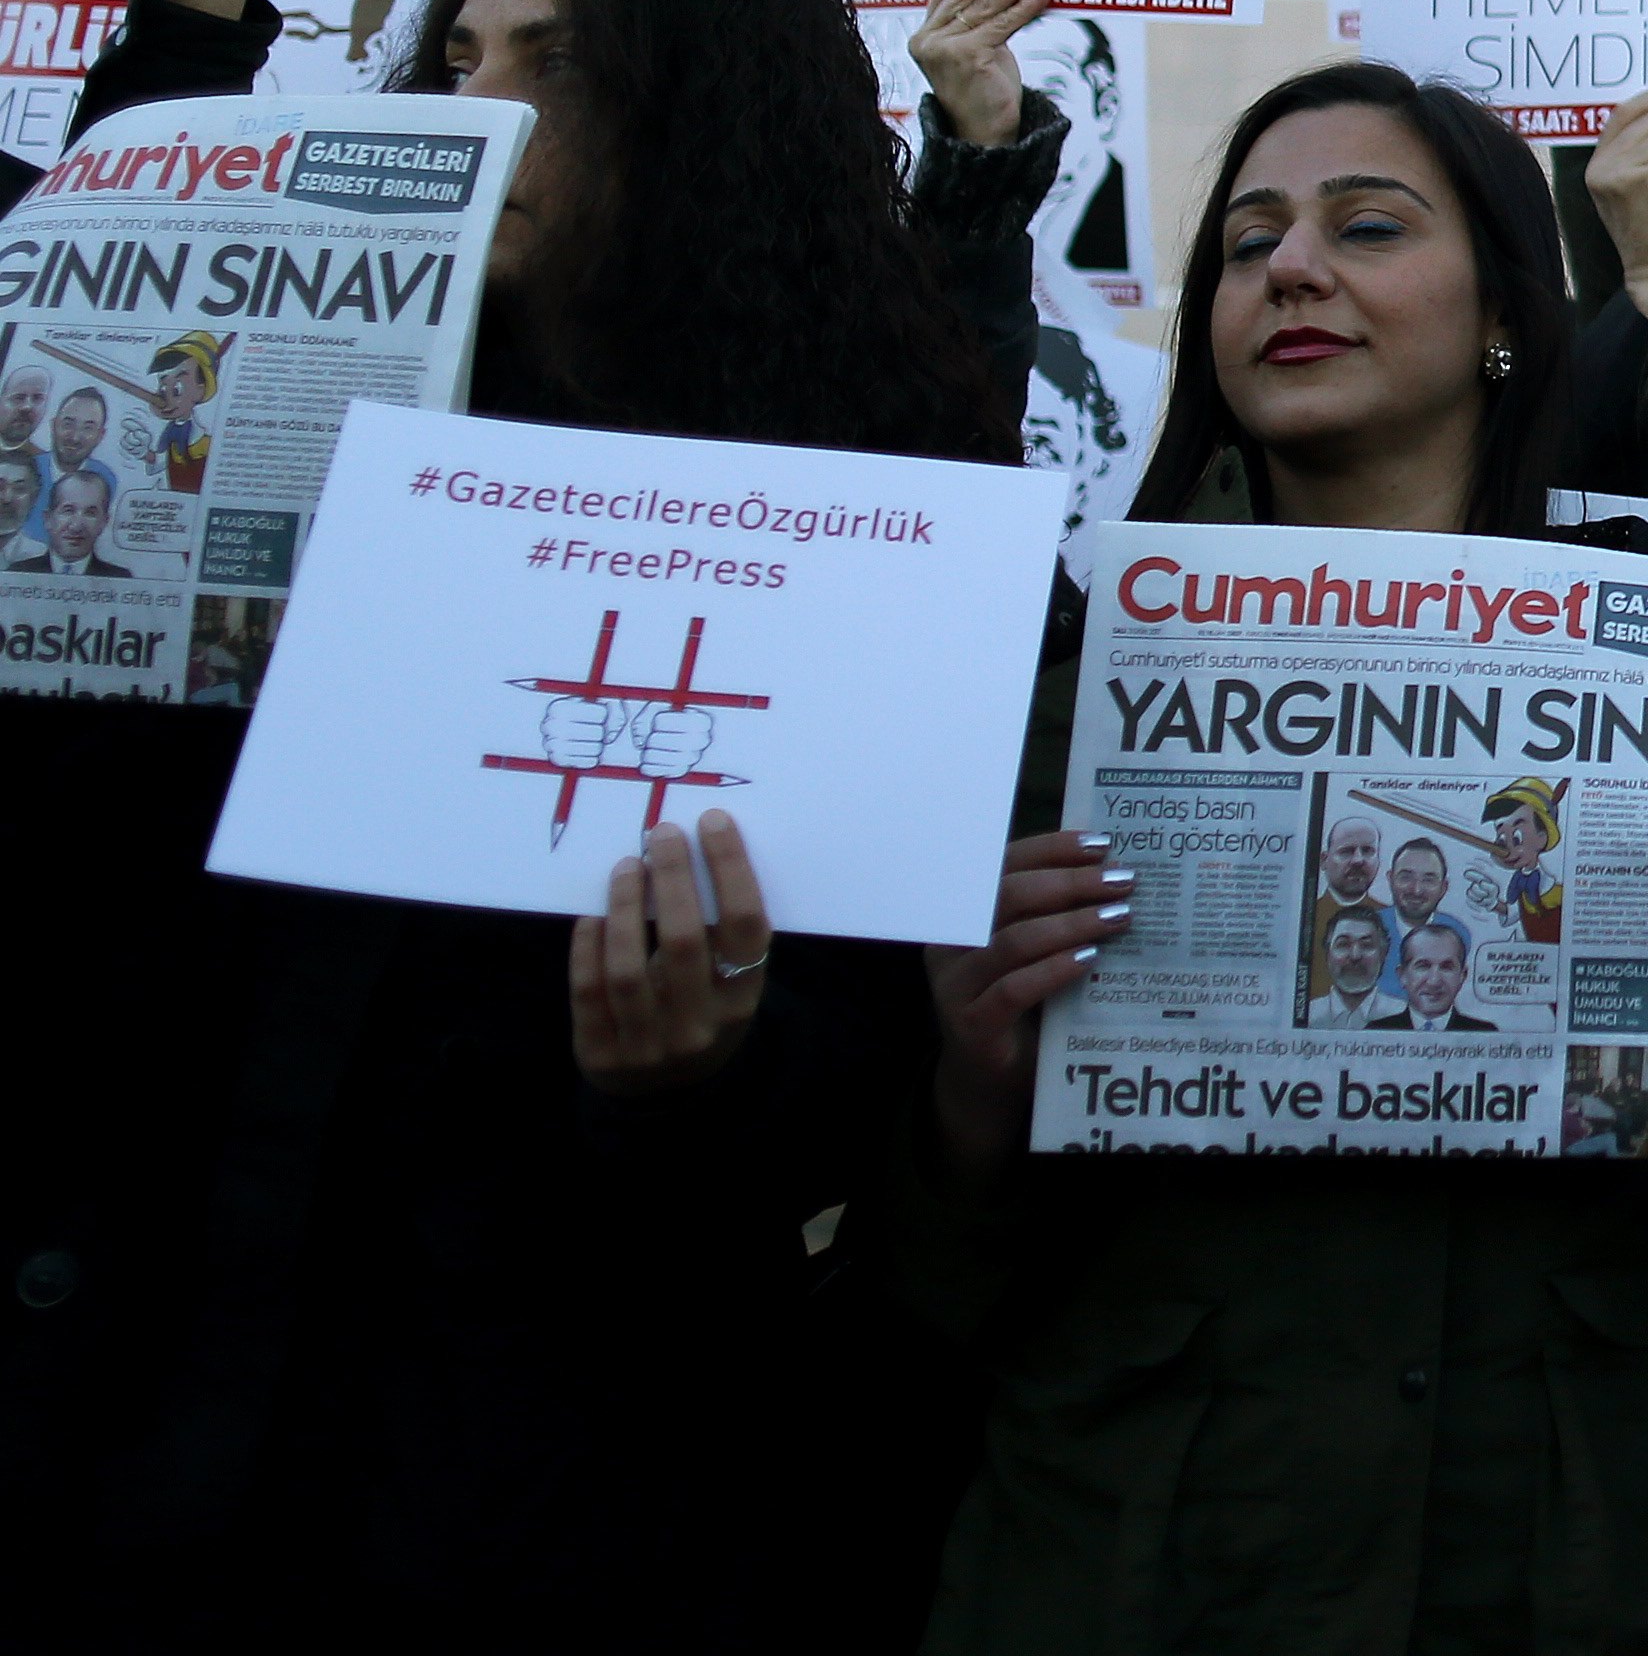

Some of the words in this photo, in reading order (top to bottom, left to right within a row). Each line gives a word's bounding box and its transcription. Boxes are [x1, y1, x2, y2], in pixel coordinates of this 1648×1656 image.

[1518, 107, 1577, 132] SAAT:
[305, 141, 473, 173] GAZETECİLERİ
[295, 173, 379, 196] SERBEST
[381, 179, 463, 203] BIRAKIN
[197, 243, 456, 326] SINAVI
[409, 465, 935, 547] #GazetecilereÖzgürlük
[527, 538, 787, 590] #FreePress
[1117, 556, 1590, 643] Cumhuriyet
[1208, 653, 1278, 671] susturma
[1281, 656, 1402, 677] operasyonunun
[1406, 656, 1451, 674] birinci
[1454, 661, 1501, 679] yılında
[1505, 663, 1609, 684] arkadaşlarımız
[1106, 676, 1502, 760] YARGININ
[1103, 794, 1189, 822] Yandaş
[1195, 796, 1255, 821] basın
[1169, 828, 1294, 858] gösteriyor
[1260, 1079, 1323, 1120] ve
[1337, 1069, 1539, 1122] baskılar
